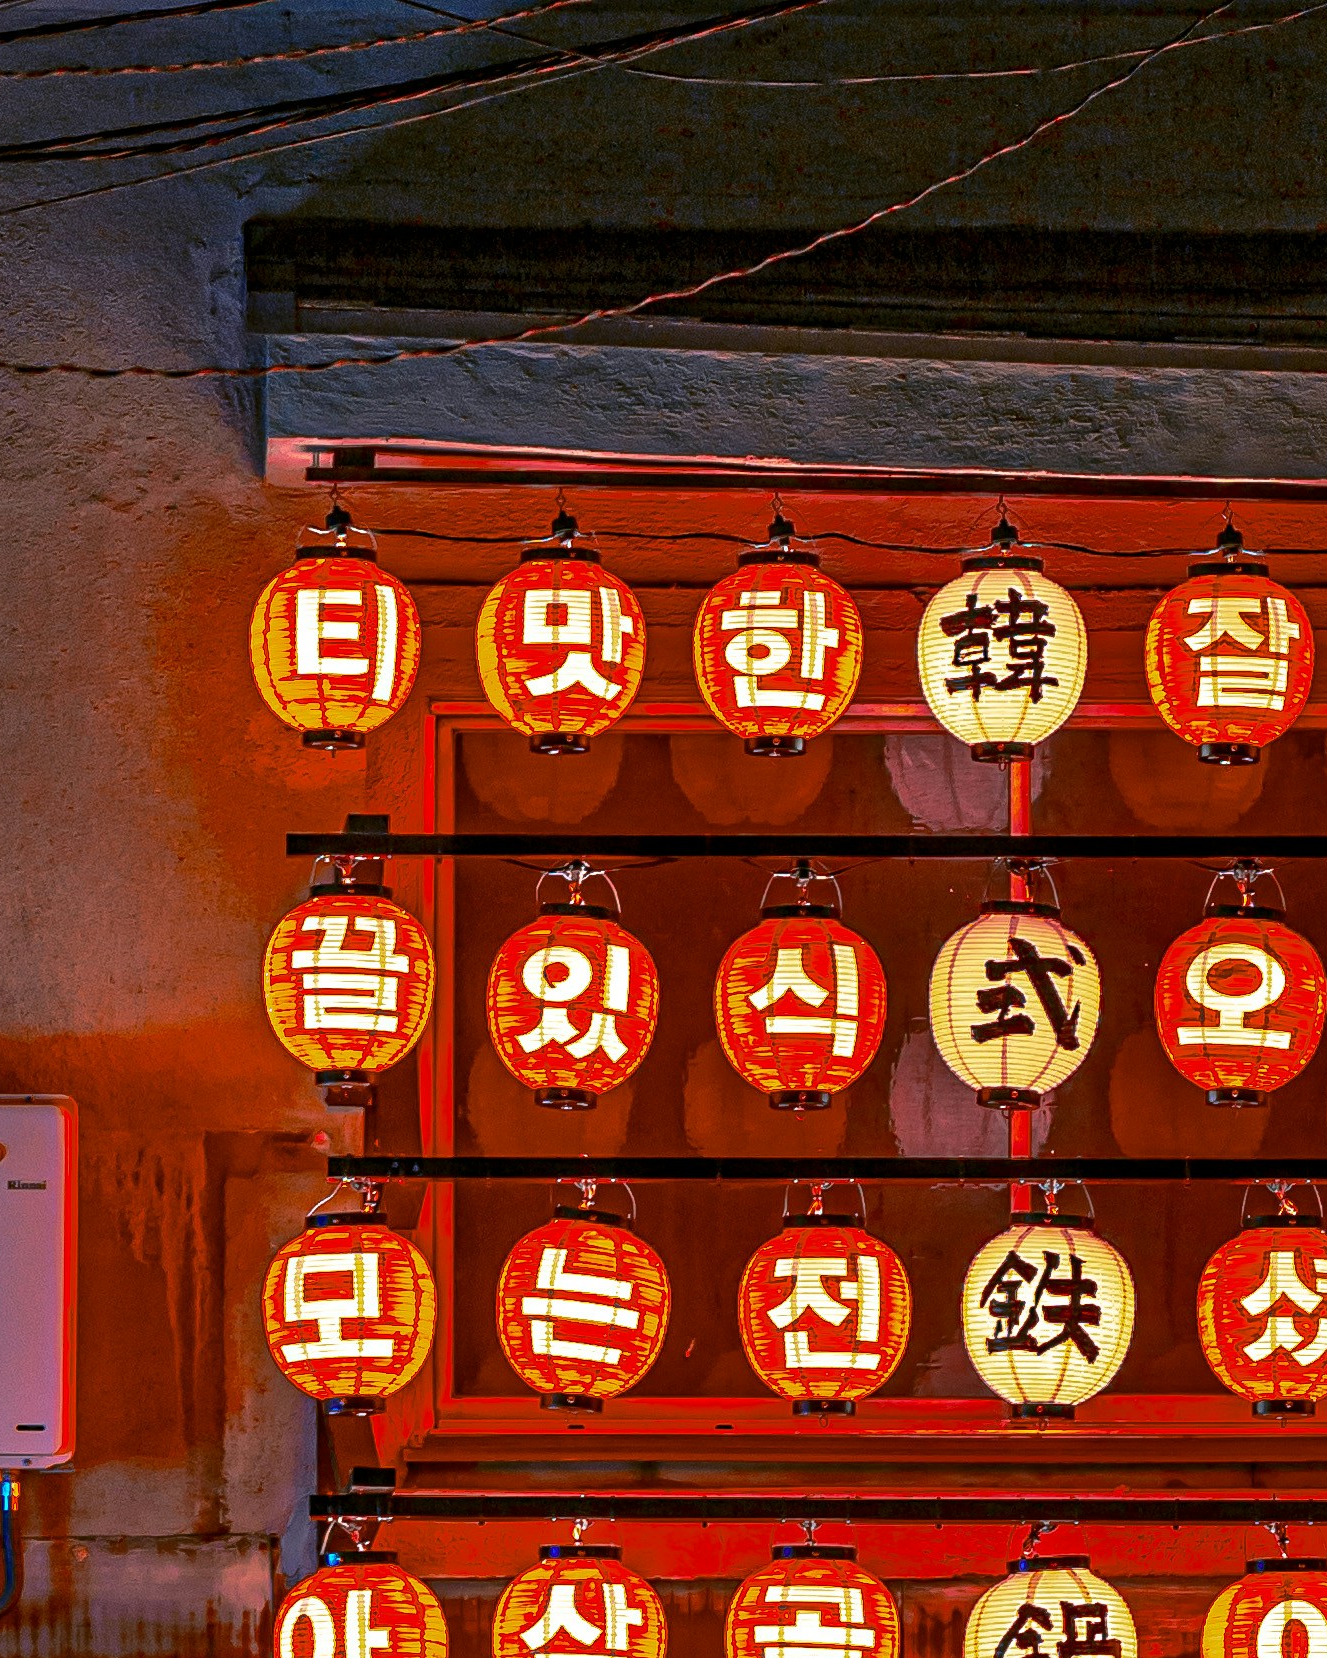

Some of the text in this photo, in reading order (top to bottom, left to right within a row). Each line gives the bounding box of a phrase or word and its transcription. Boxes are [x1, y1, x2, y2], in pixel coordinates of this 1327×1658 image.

[297, 585, 397, 701] 티
[524, 588, 632, 699] 맛
[722, 591, 838, 710] 한
[940, 588, 1059, 704] 韓
[1184, 598, 1300, 710] 잘
[292, 917, 409, 1032] 끌
[518, 945, 629, 1062] 있
[749, 945, 857, 1056] 식
[971, 938, 1080, 1050] 式
[1178, 945, 1290, 1049] 오
[282, 1253, 393, 1361] 모
[523, 1249, 639, 1364] 는
[768, 1256, 880, 1369] 전
[981, 1251, 1101, 1364] 鉄
